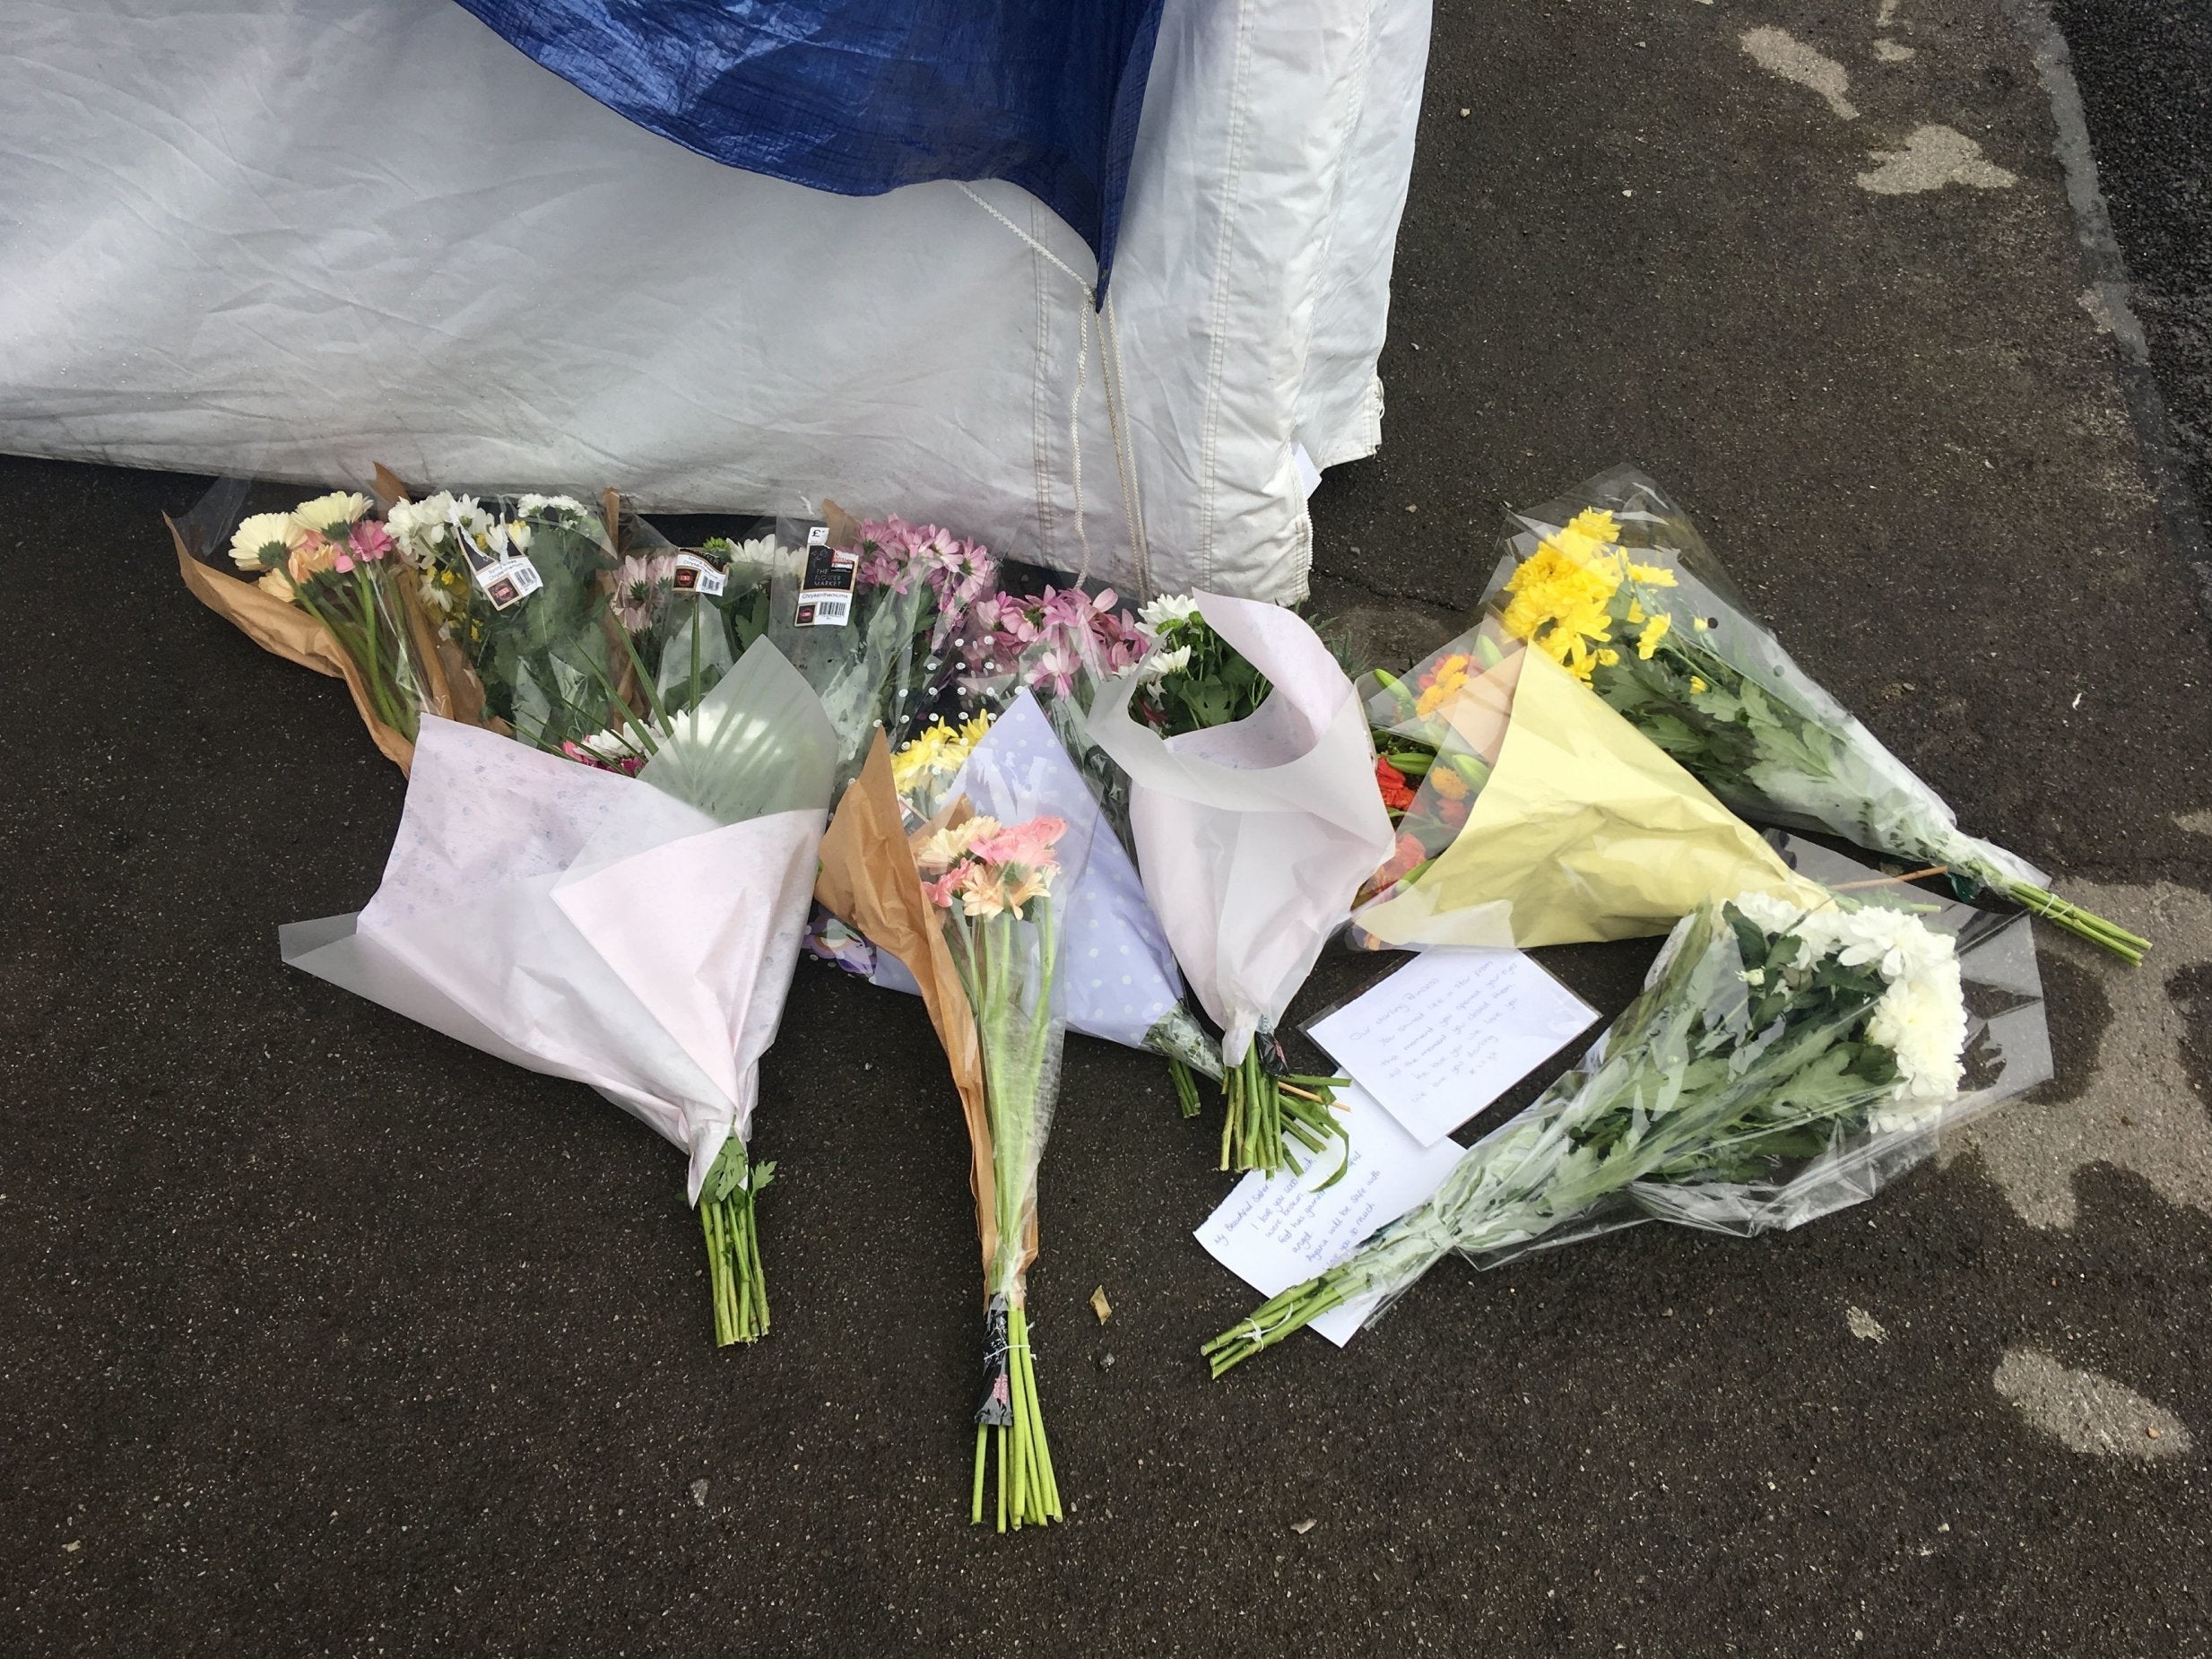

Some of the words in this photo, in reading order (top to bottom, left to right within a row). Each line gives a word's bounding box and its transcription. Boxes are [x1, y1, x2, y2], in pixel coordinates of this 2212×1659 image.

[1349, 1025, 1370, 1040] Our
[1214, 1233, 1228, 1246] My
[1251, 1183, 1269, 1202] Sister
[1338, 1205, 1350, 1215] be
[1289, 1215, 1305, 1228] has
[993, 1377, 1002, 1399] FOOD
[1000, 1374, 1009, 1405] FLOWER
